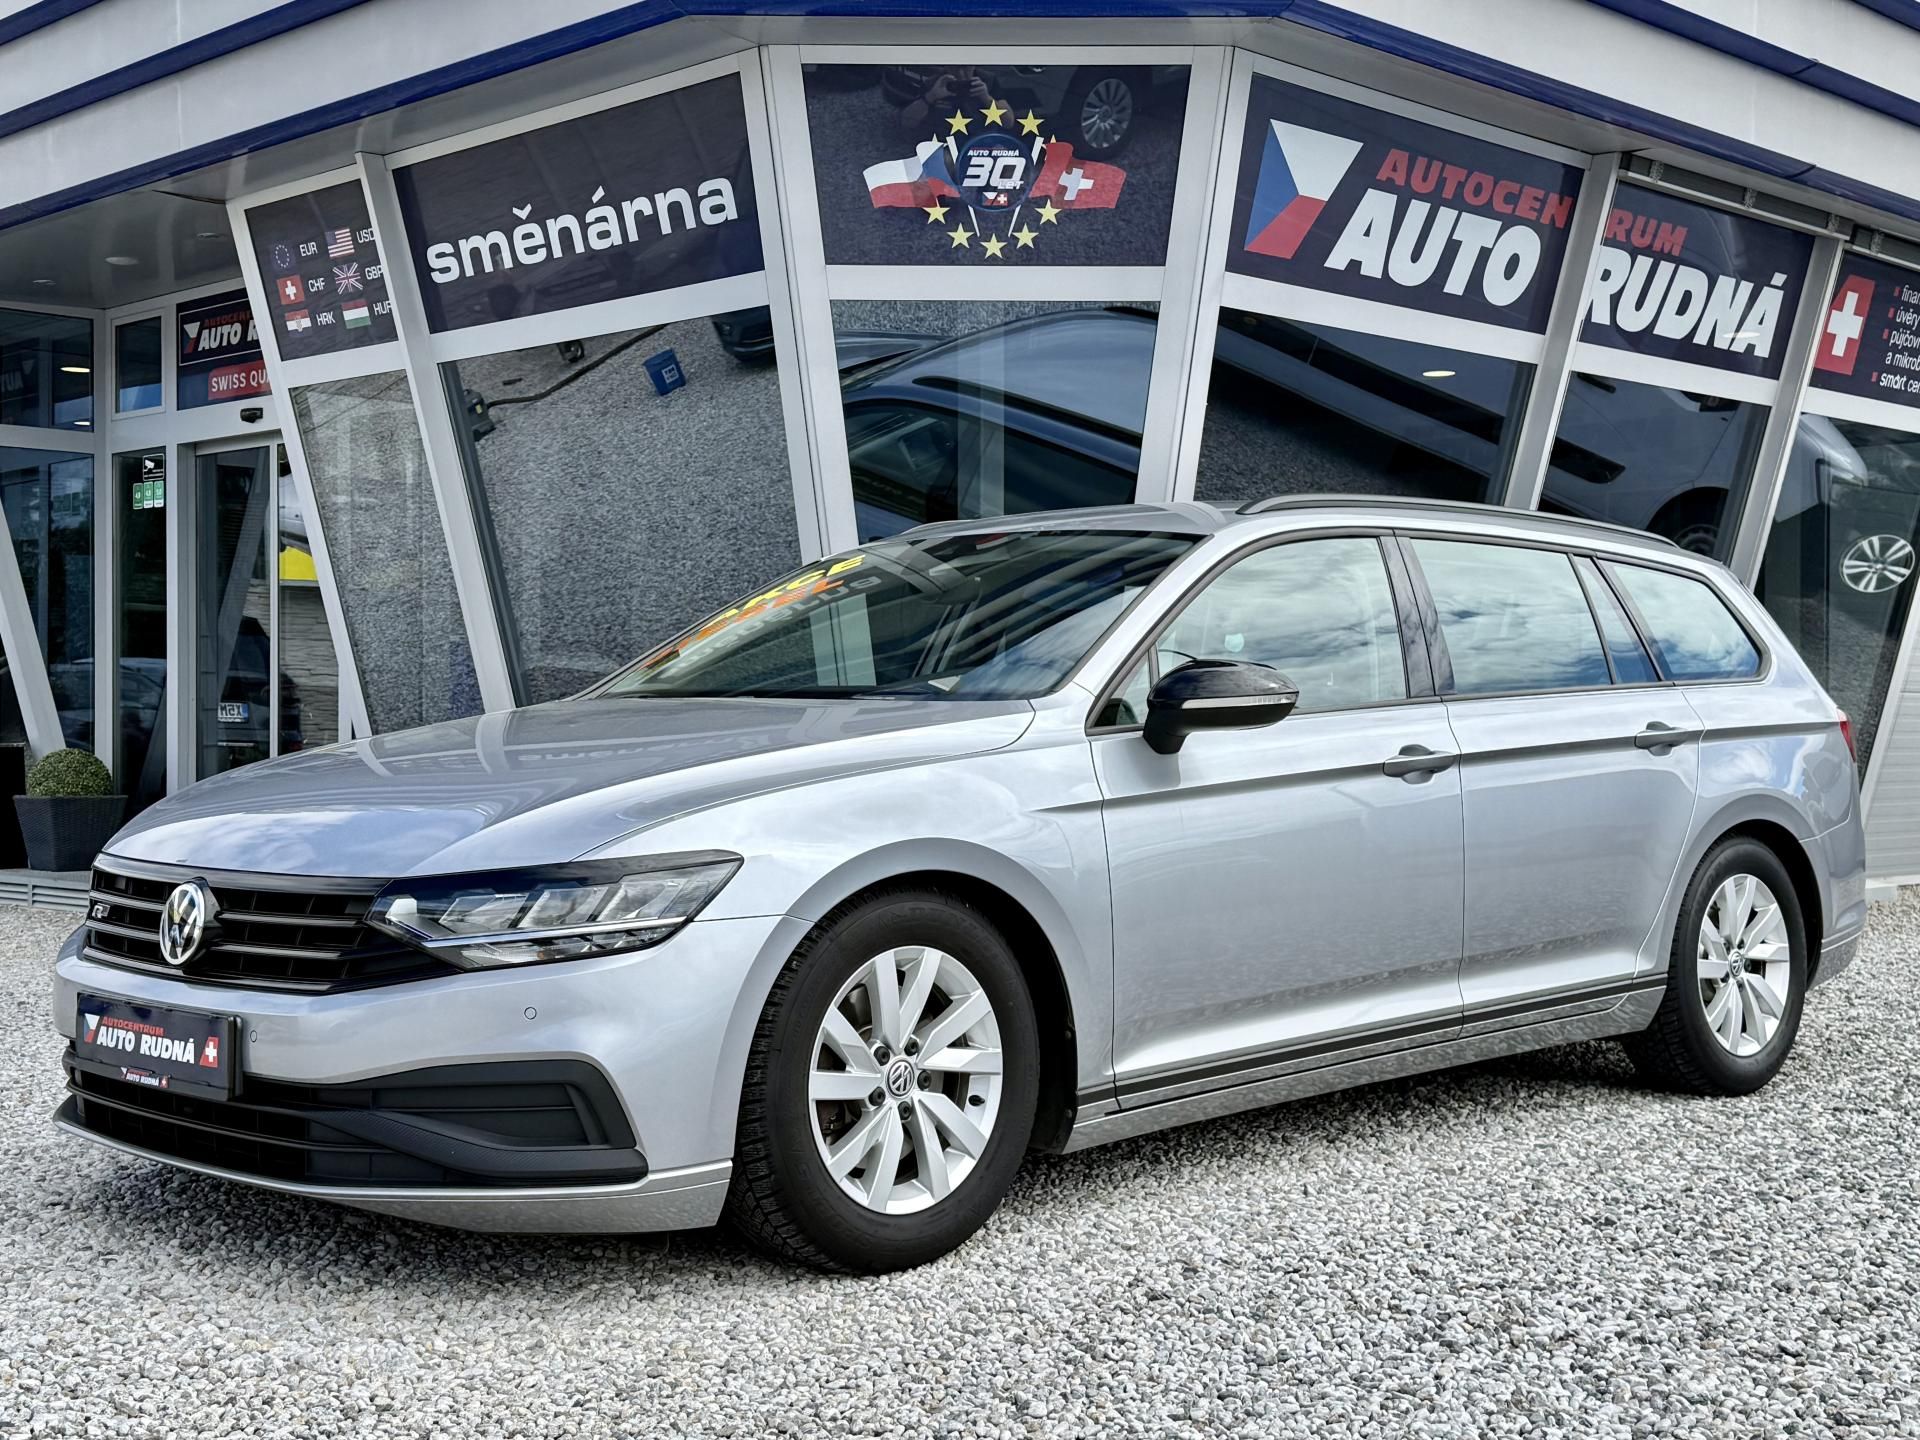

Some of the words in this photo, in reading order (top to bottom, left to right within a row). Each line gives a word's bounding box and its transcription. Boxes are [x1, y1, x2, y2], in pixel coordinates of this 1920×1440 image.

[962, 157, 1026, 187] 30
[356, 227, 376, 244] USD
[426, 177, 739, 284] směnárna
[299, 241, 318, 257] EUR
[1324, 188, 1541, 306] AUTO
[1583, 246, 1788, 358] RUDNÁ
[308, 277, 326, 292] CHF
[315, 311, 336, 326] HRK
[198, 322, 242, 351] AUTO
[1885, 352, 1893, 365] a
[211, 373, 247, 392] SWISS
[249, 369, 270, 387] QU
[1879, 372, 1907, 390] smart
[102, 1016, 164, 1036] AUTOCENTRUM
[97, 1026, 136, 1053] AUTO
[140, 1034, 195, 1065] RUDNÁ
